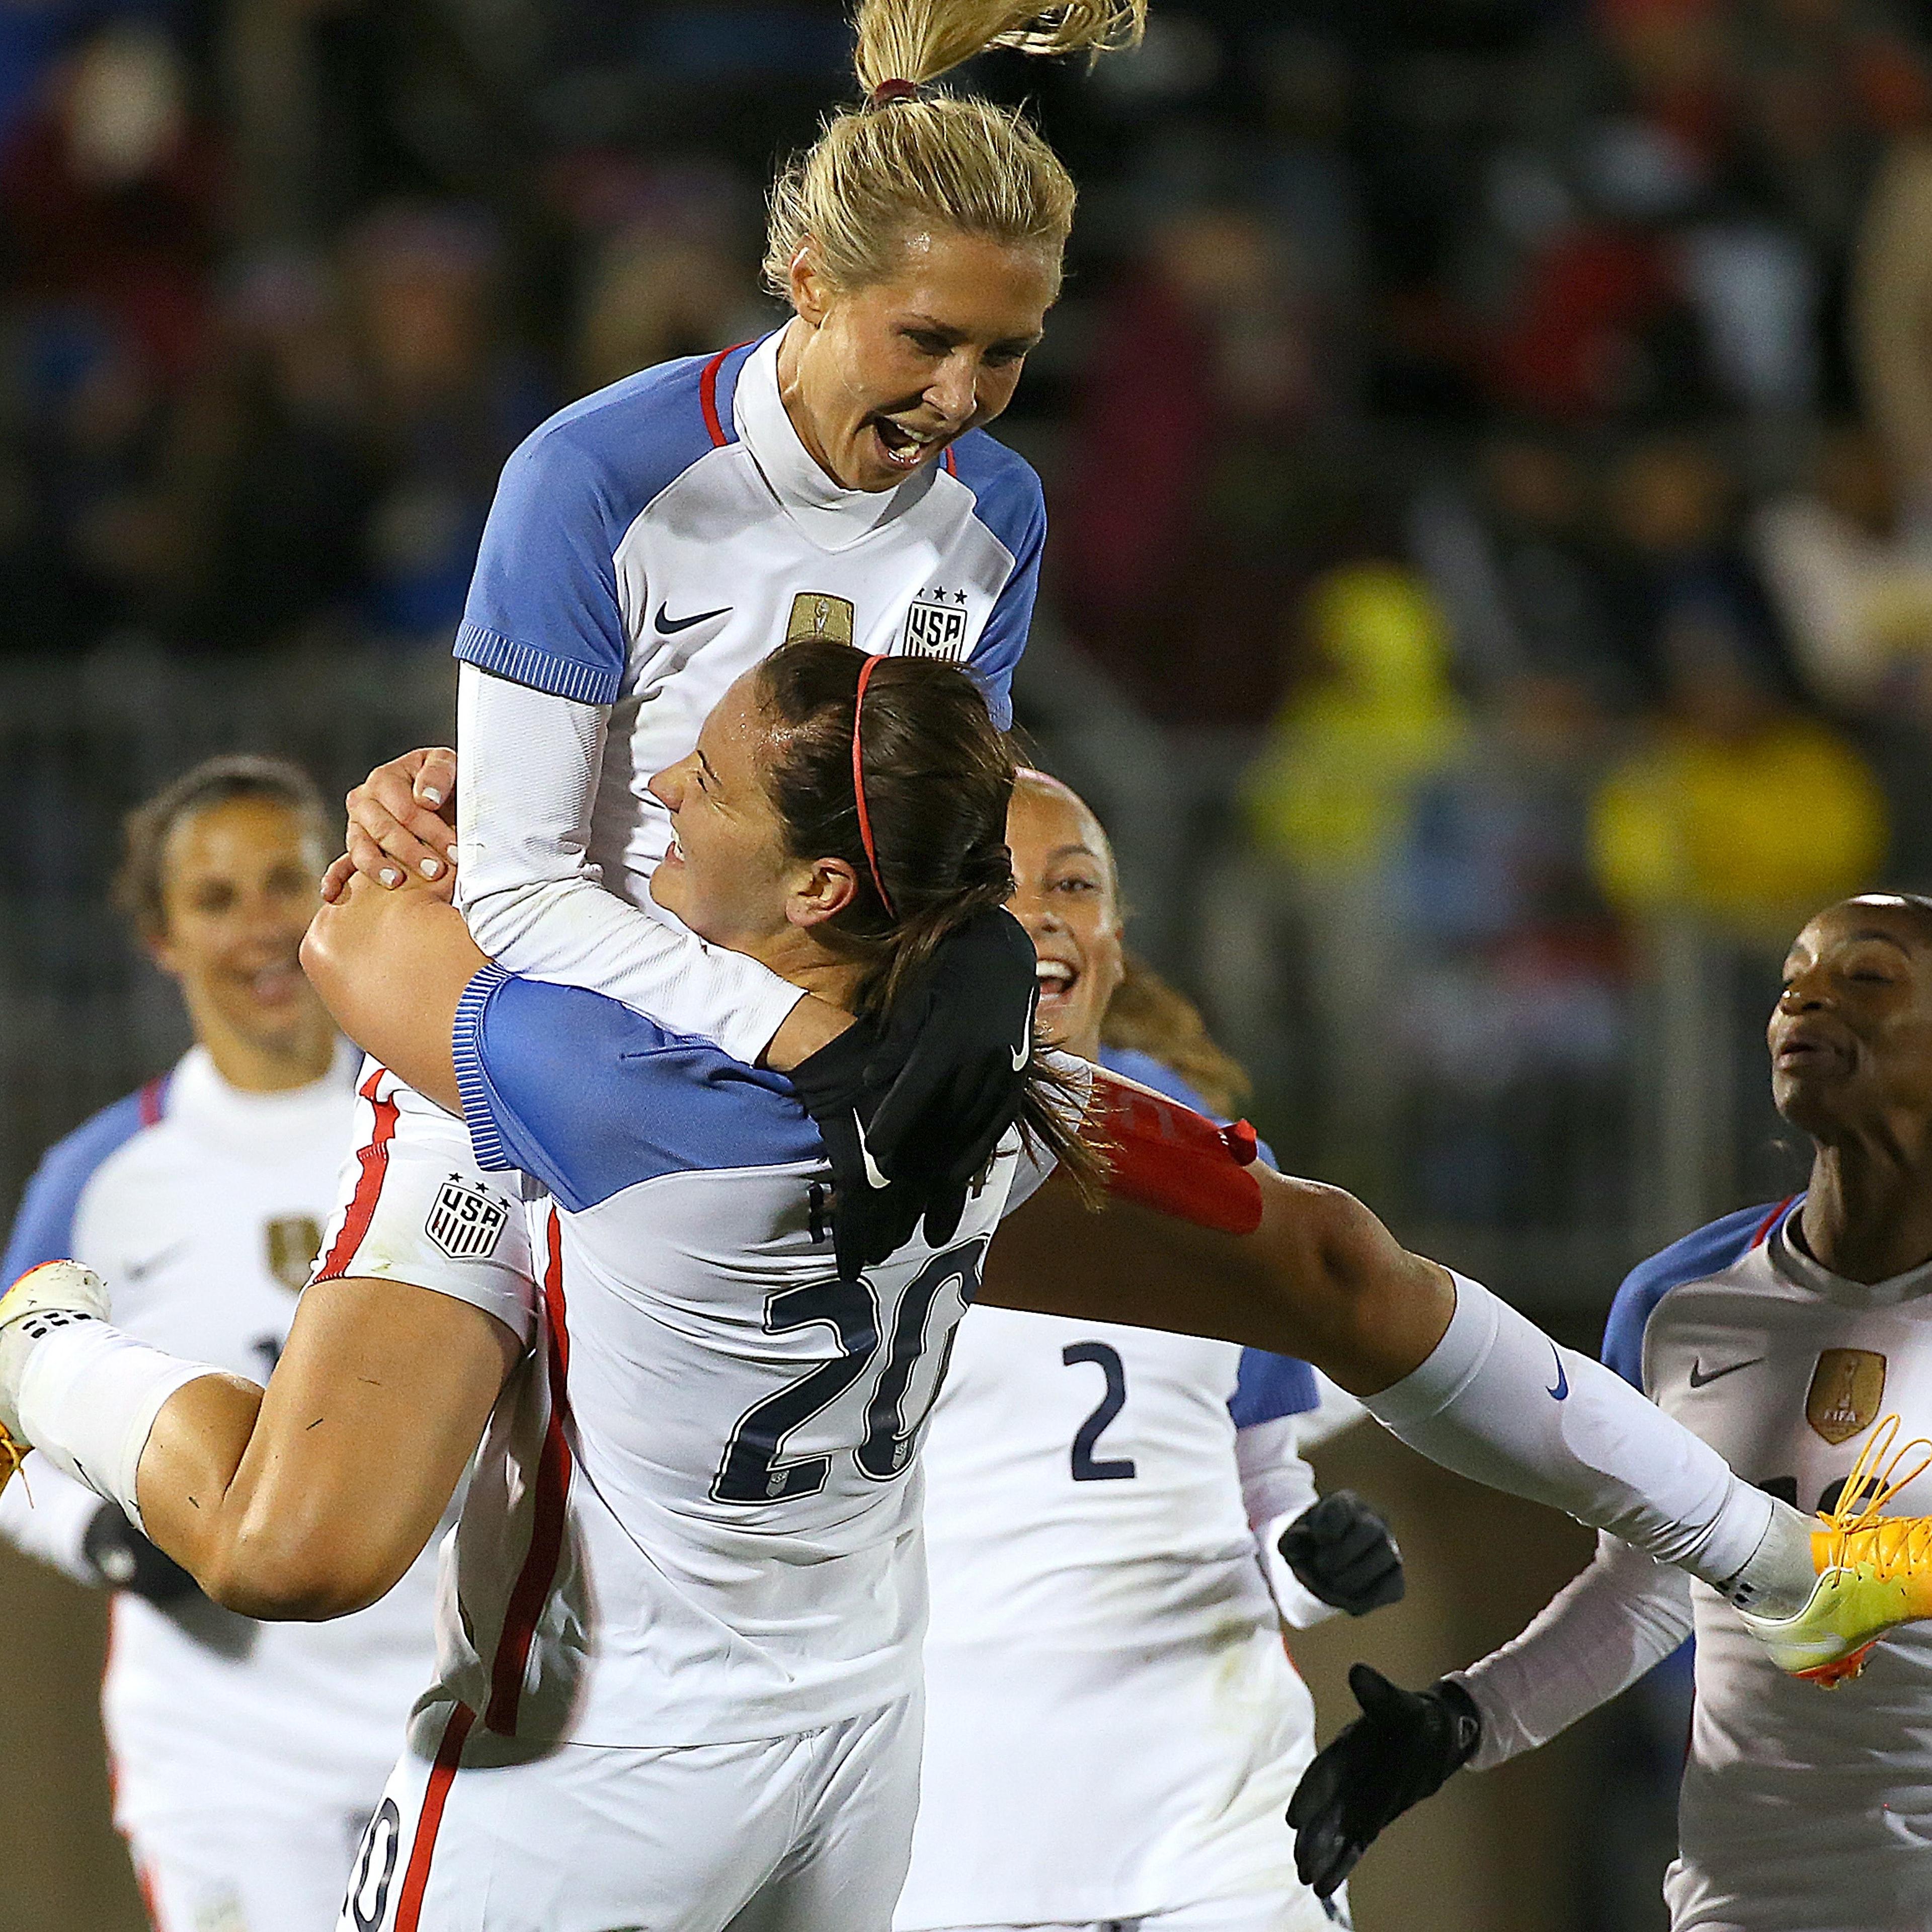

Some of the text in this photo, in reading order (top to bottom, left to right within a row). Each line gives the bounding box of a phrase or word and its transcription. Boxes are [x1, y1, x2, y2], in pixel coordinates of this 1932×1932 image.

[912, 608, 961, 648] USA
[442, 1188, 502, 1228] USA
[708, 1233, 991, 1505] 20
[1063, 1342, 1136, 1481] 2
[1823, 1408, 1857, 1422] FIFA
[342, 1797, 400, 1932] 0
